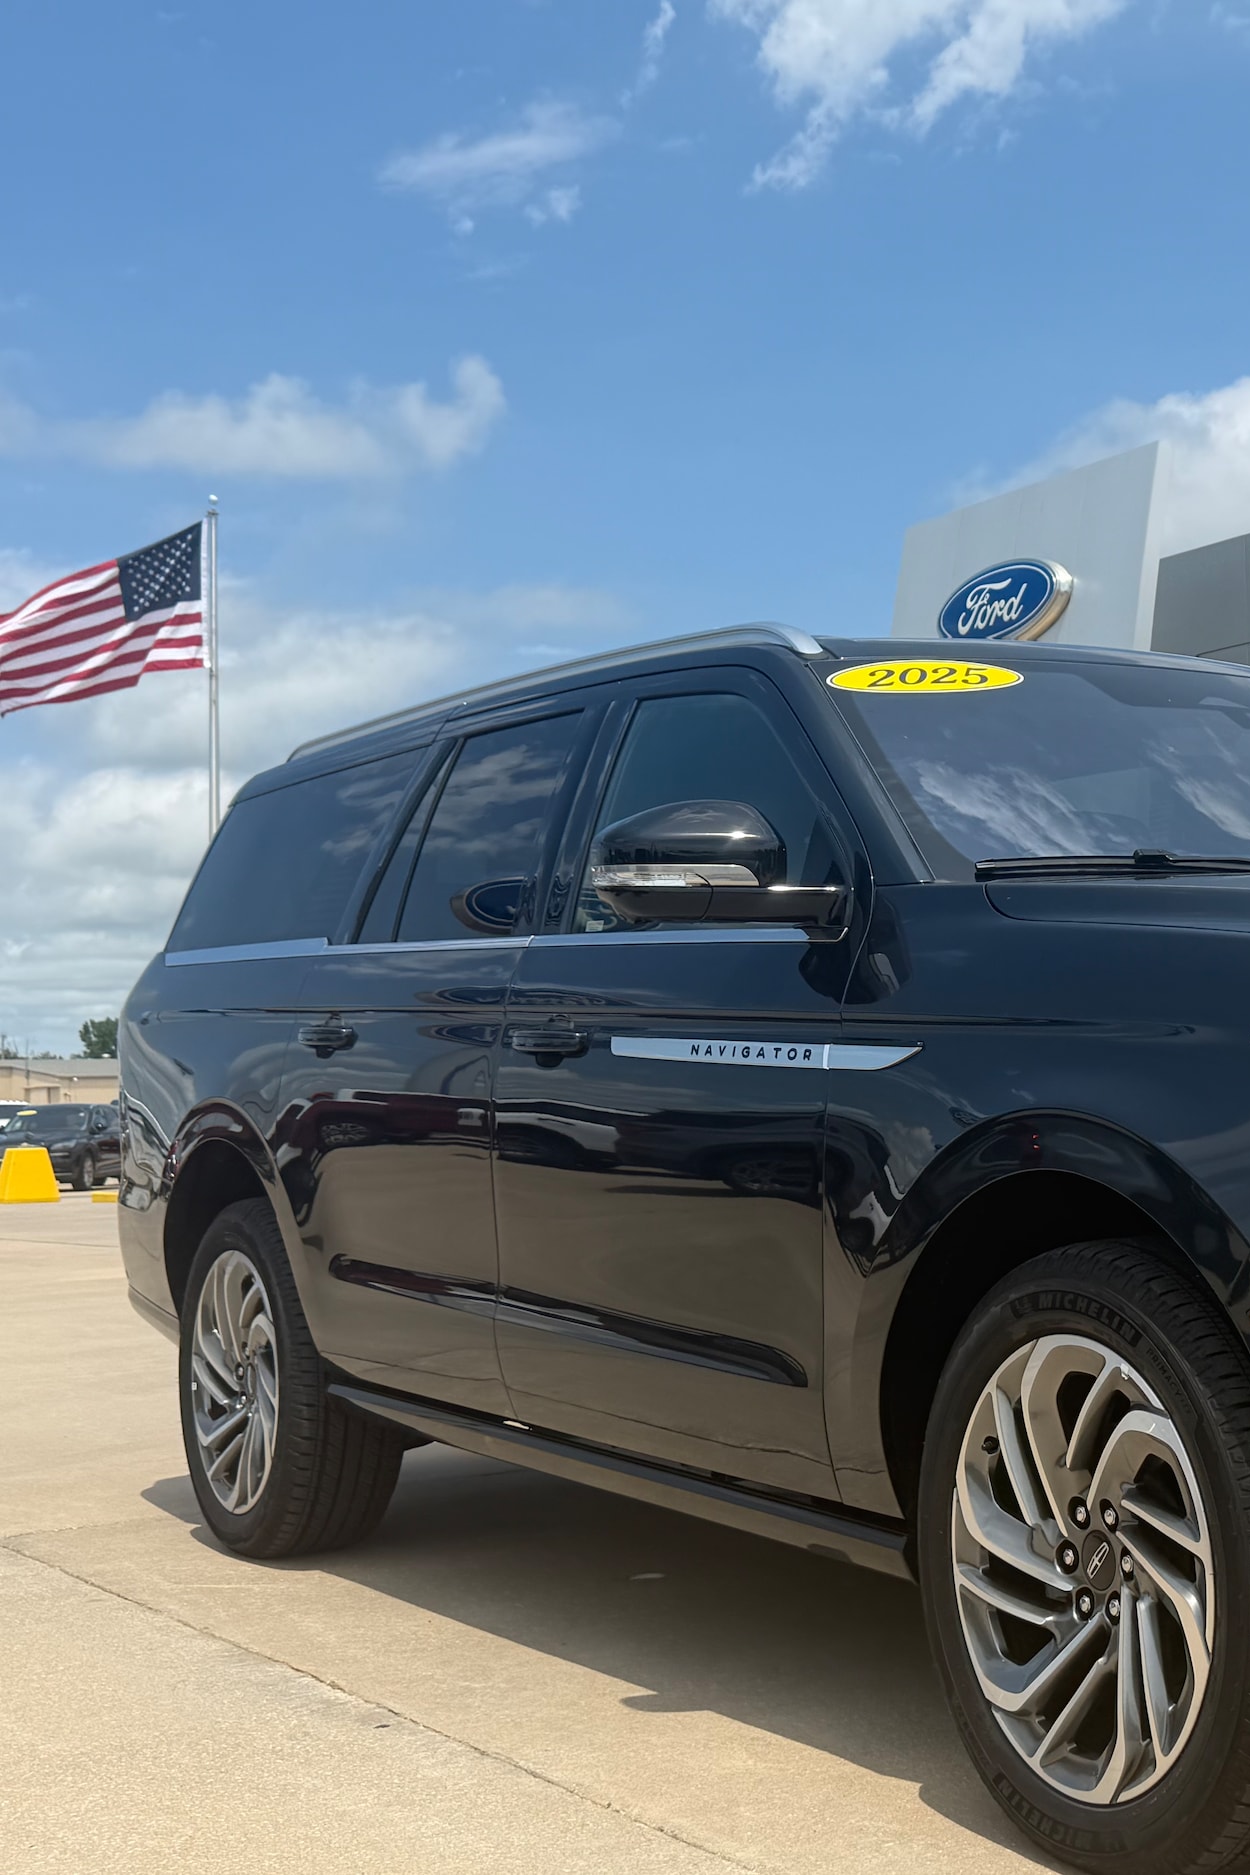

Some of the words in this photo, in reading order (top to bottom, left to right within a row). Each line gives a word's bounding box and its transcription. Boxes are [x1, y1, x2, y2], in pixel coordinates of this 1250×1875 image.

[958, 578, 1028, 635] Ford
[868, 667, 988, 687] 2025
[691, 1044, 812, 1061] NAVIGATOR
[1039, 1291, 1136, 1343] MICHELIN
